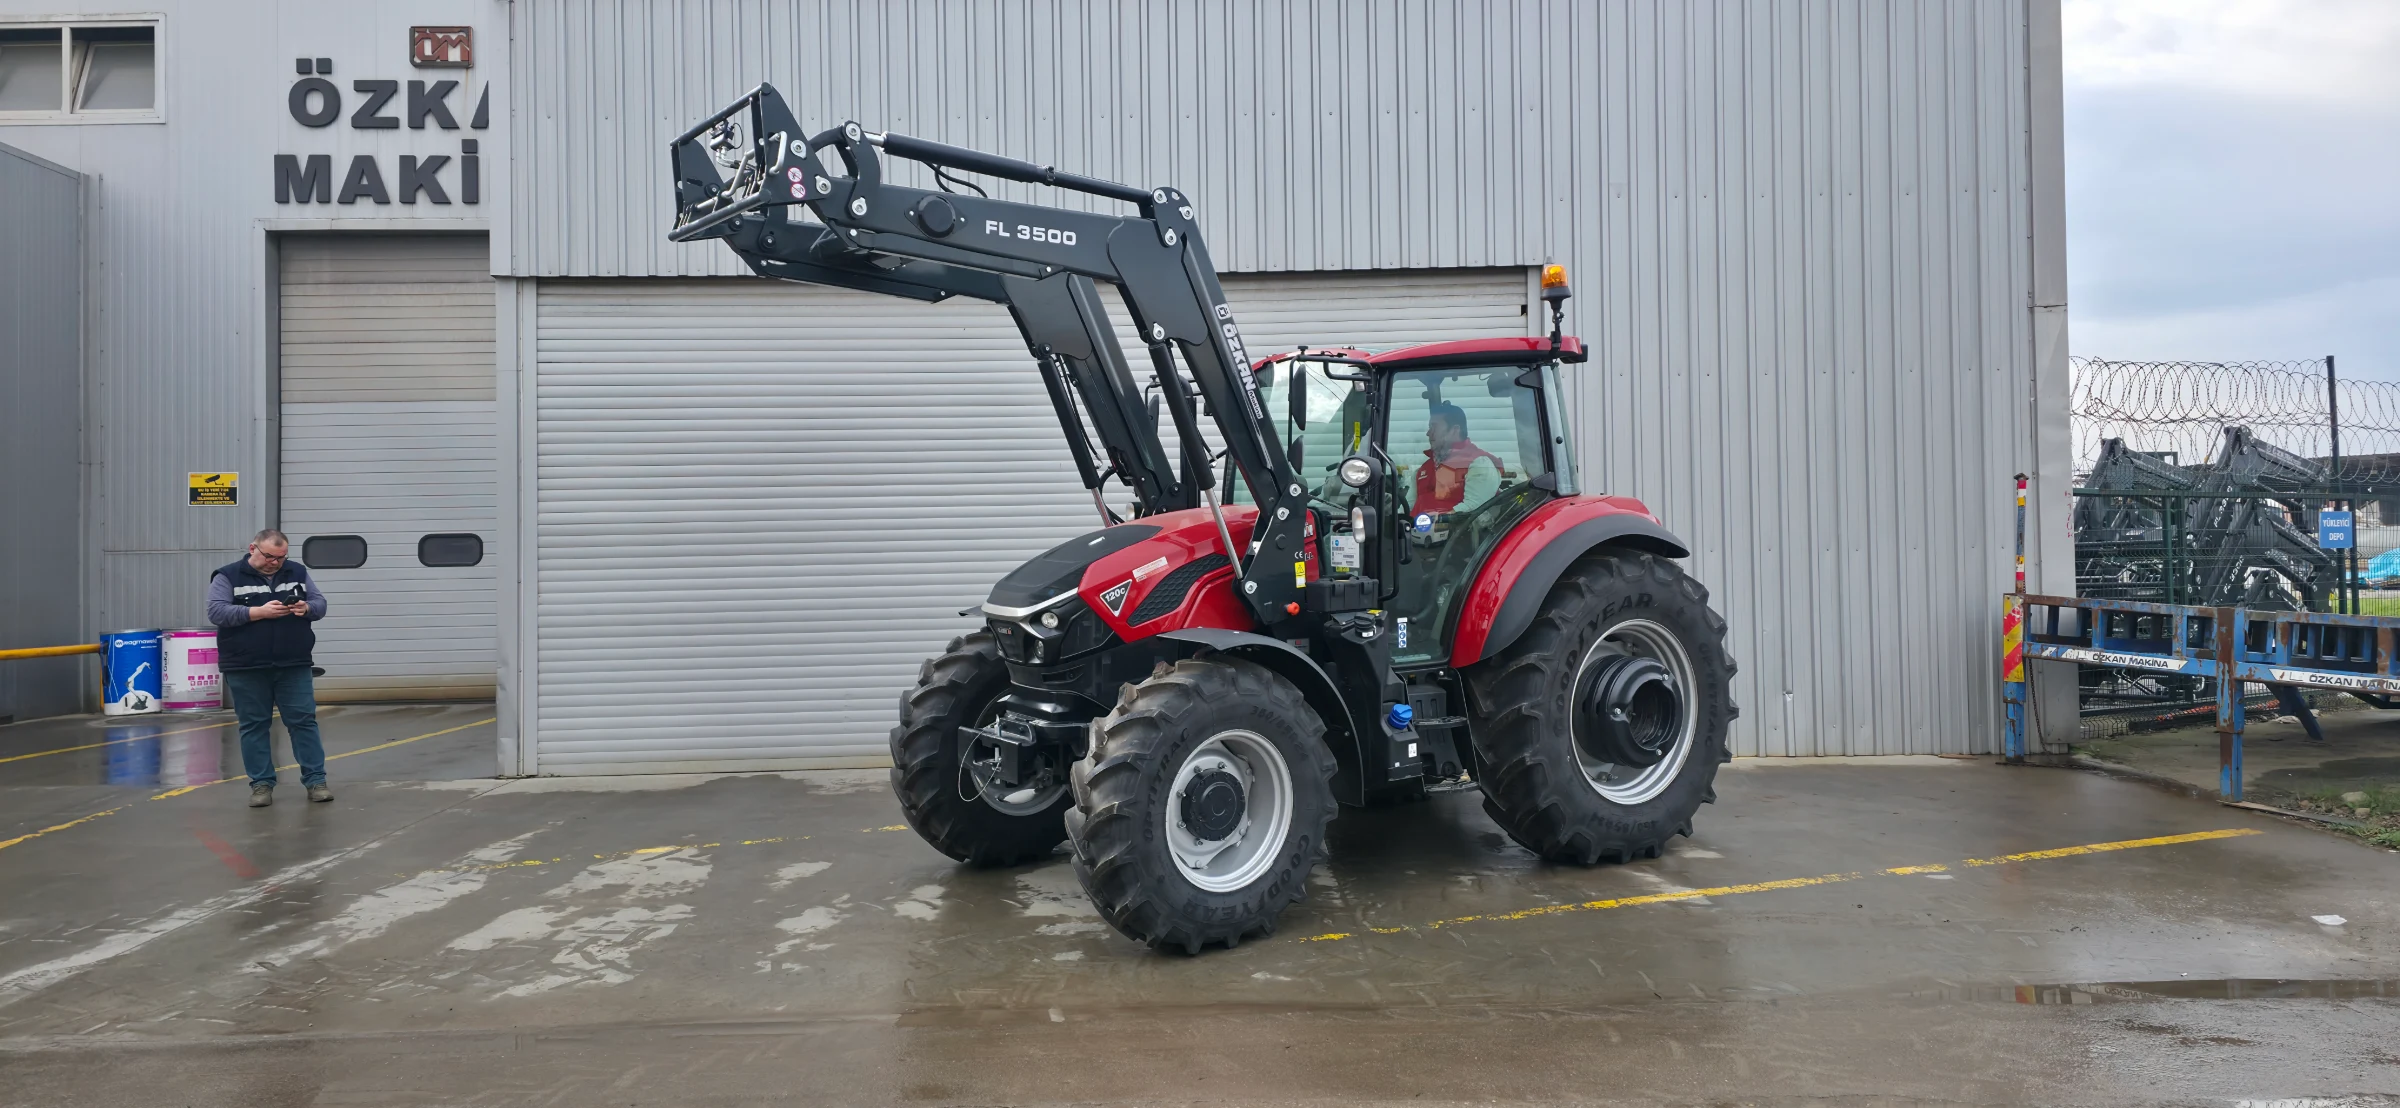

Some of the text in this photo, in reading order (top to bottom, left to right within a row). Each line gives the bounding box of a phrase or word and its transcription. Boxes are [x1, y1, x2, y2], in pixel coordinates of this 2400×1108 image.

[985, 219, 1077, 246] FL 3500
[1222, 323, 1257, 391] ÖZKAN
[2328, 532, 2345, 541] DEPO
[1553, 593, 1653, 737] GOODYEAR
[2092, 652, 2127, 664] ÖZKAN
[2309, 673, 2353, 687] ÖZKAN
[1182, 834, 1310, 921] GOODYEAR
